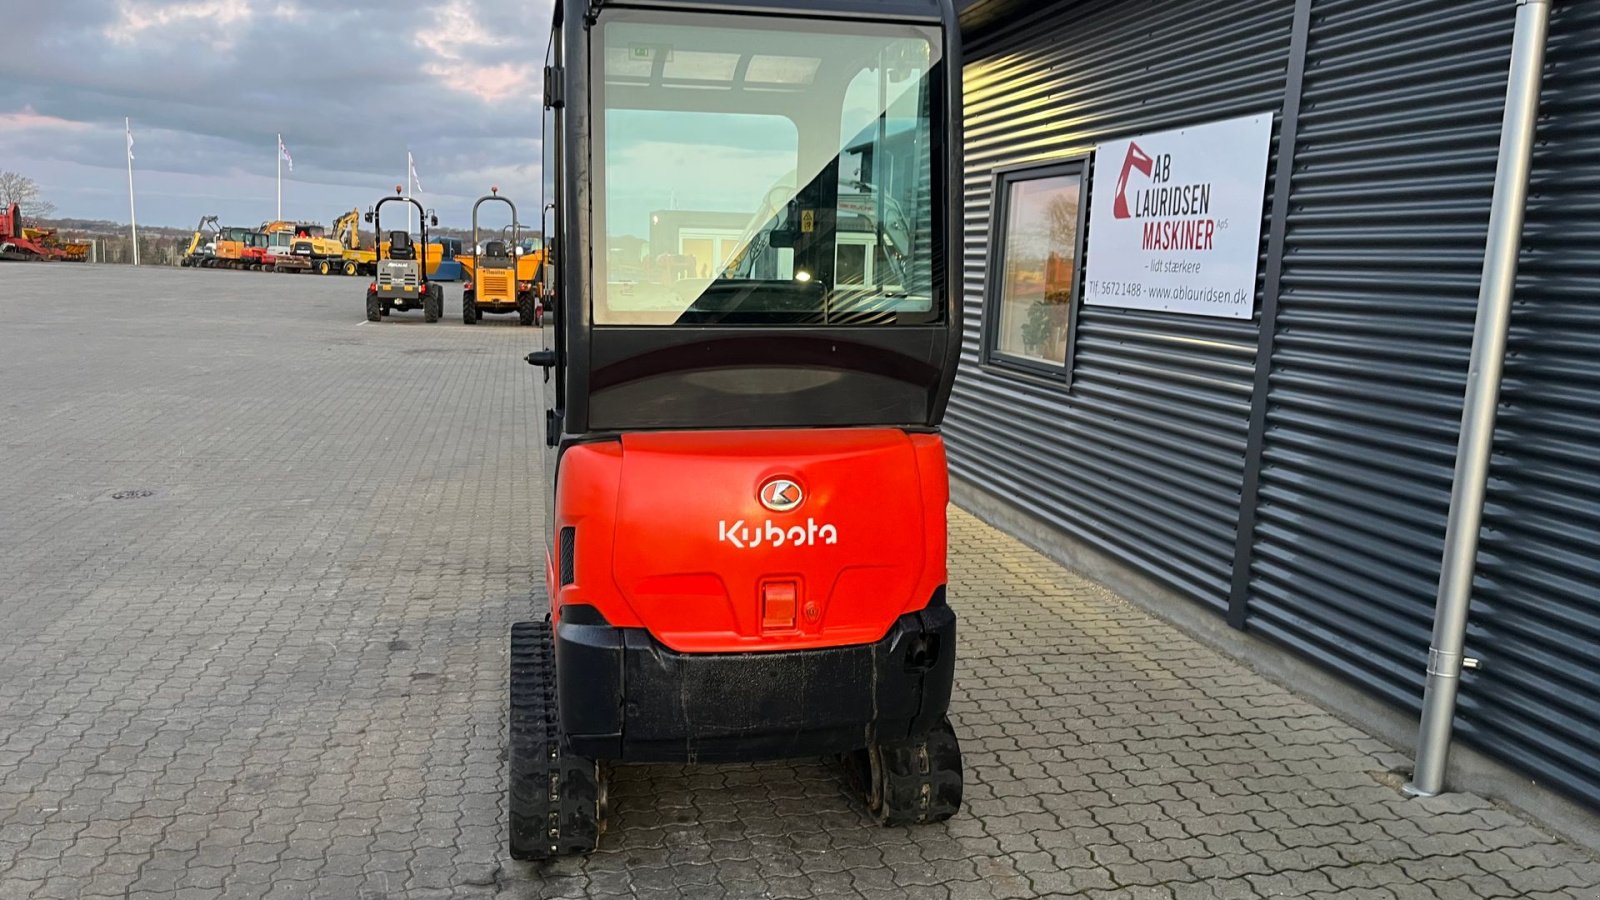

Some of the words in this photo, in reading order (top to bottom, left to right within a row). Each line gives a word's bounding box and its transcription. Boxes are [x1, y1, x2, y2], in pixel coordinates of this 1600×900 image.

[1153, 153, 1171, 184] AB
[1135, 183, 1211, 218] LAURIDSEN
[1142, 219, 1214, 250] MASKINER
[1216, 218, 1229, 231] ApS
[1150, 259, 1163, 273] lidt
[1164, 260, 1201, 274] stærkere
[1089, 280, 1100, 297] Tlf.
[1101, 281, 1120, 296] 5672
[1121, 282, 1142, 297] 1488
[1148, 285, 1248, 305] www.ablauridsen.dk
[719, 517, 837, 548] Kubota
